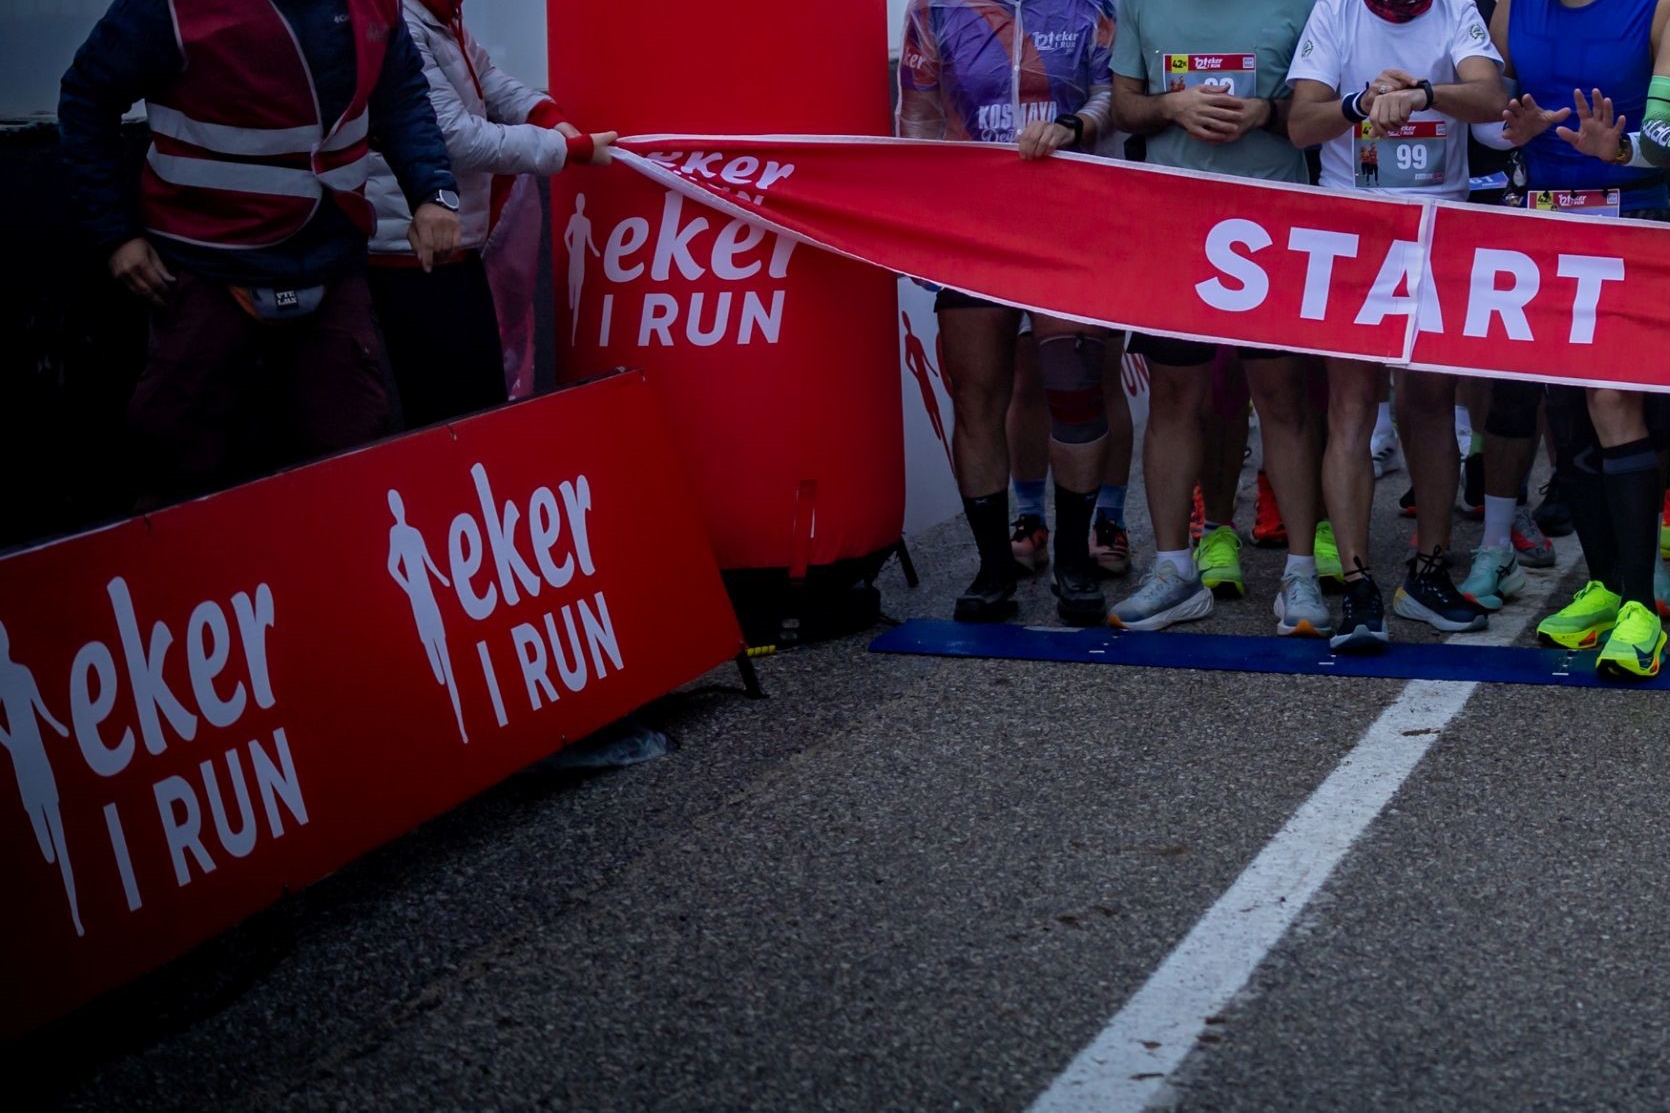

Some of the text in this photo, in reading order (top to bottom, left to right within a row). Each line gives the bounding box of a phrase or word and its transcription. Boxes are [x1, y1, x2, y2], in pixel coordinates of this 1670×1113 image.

[1396, 144, 1427, 170] 99
[599, 290, 785, 347] I RUN
[1195, 218, 1625, 344] START
[448, 463, 596, 620] eker
[69, 577, 275, 777] eker
[477, 592, 624, 728] I RUN
[104, 728, 309, 911] I RUN
